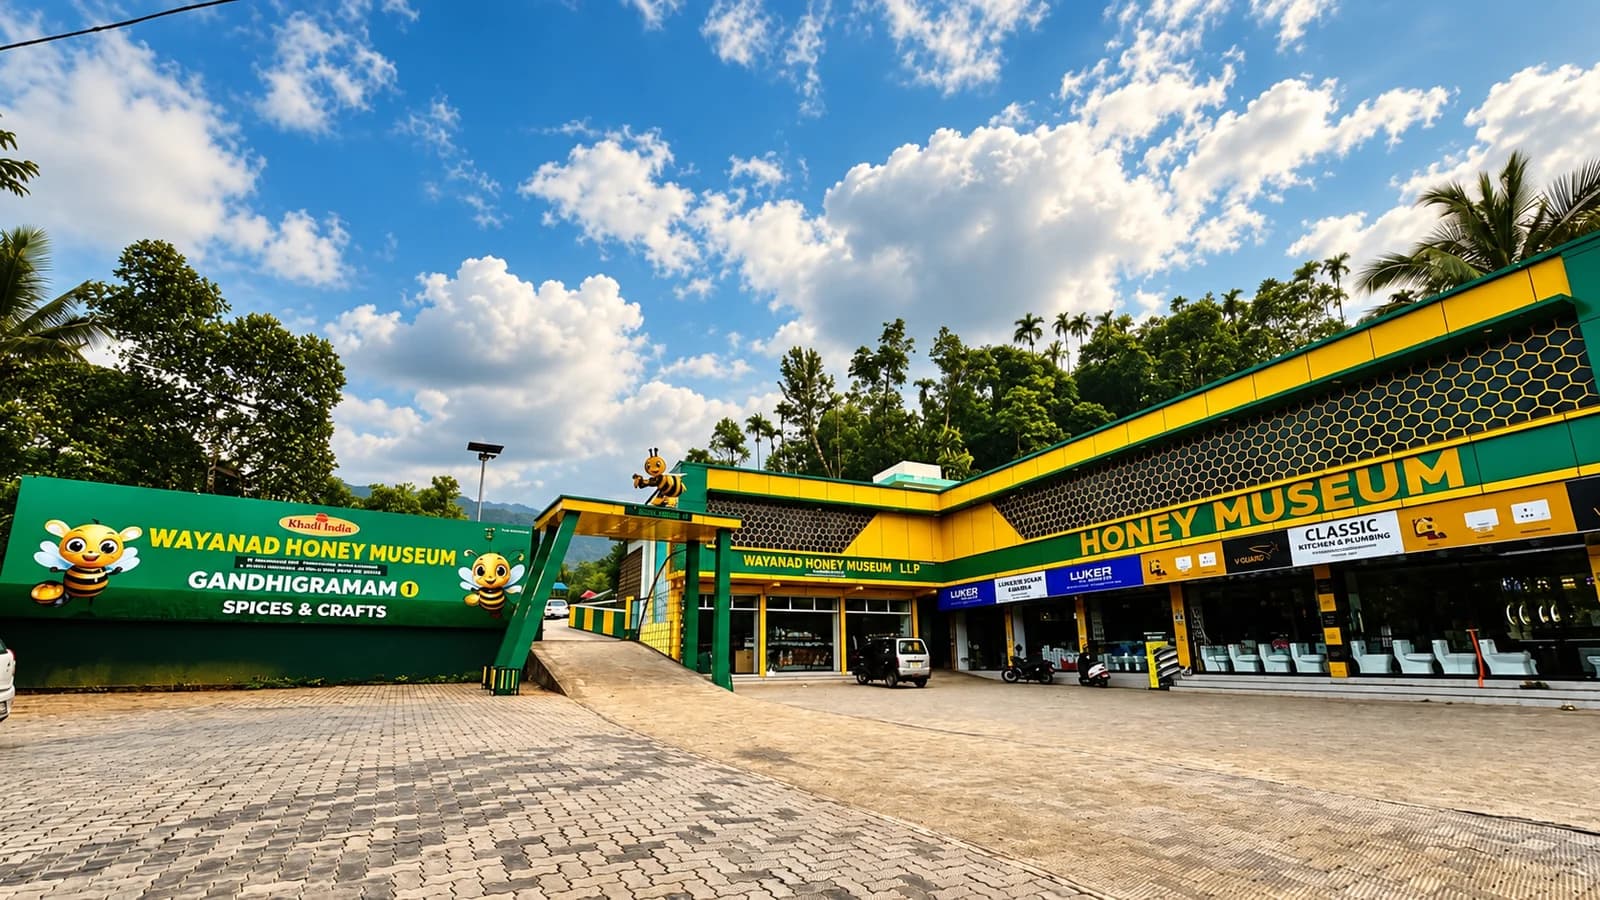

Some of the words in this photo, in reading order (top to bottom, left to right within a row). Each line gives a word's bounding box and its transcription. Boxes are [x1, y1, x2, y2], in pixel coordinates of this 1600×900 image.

[1080, 506, 1200, 556] HONEY
[1213, 448, 1464, 530] MUSEUM
[288, 518, 321, 531] Khadi
[324, 522, 352, 534] India
[1305, 519, 1379, 541] CLASSIC
[150, 527, 280, 555] WAYANAD
[285, 538, 366, 561] HONEY
[370, 544, 456, 566] MUSEUM
[1298, 540, 1336, 551] KITCHEN
[1337, 538, 1343, 546] &
[1344, 532, 1391, 545] PLUMBING
[743, 554, 802, 568] WAYANAD
[805, 558, 845, 571] HONEY
[846, 561, 892, 573] MUSEUM
[900, 563, 920, 575] LLP
[1070, 566, 1113, 581] LUKER
[187, 571, 397, 597] GANDHIGRAMAM
[950, 587, 978, 599] LUKER
[222, 600, 293, 615] SPICES
[298, 602, 312, 616] &
[317, 603, 387, 618] CRAFTS
